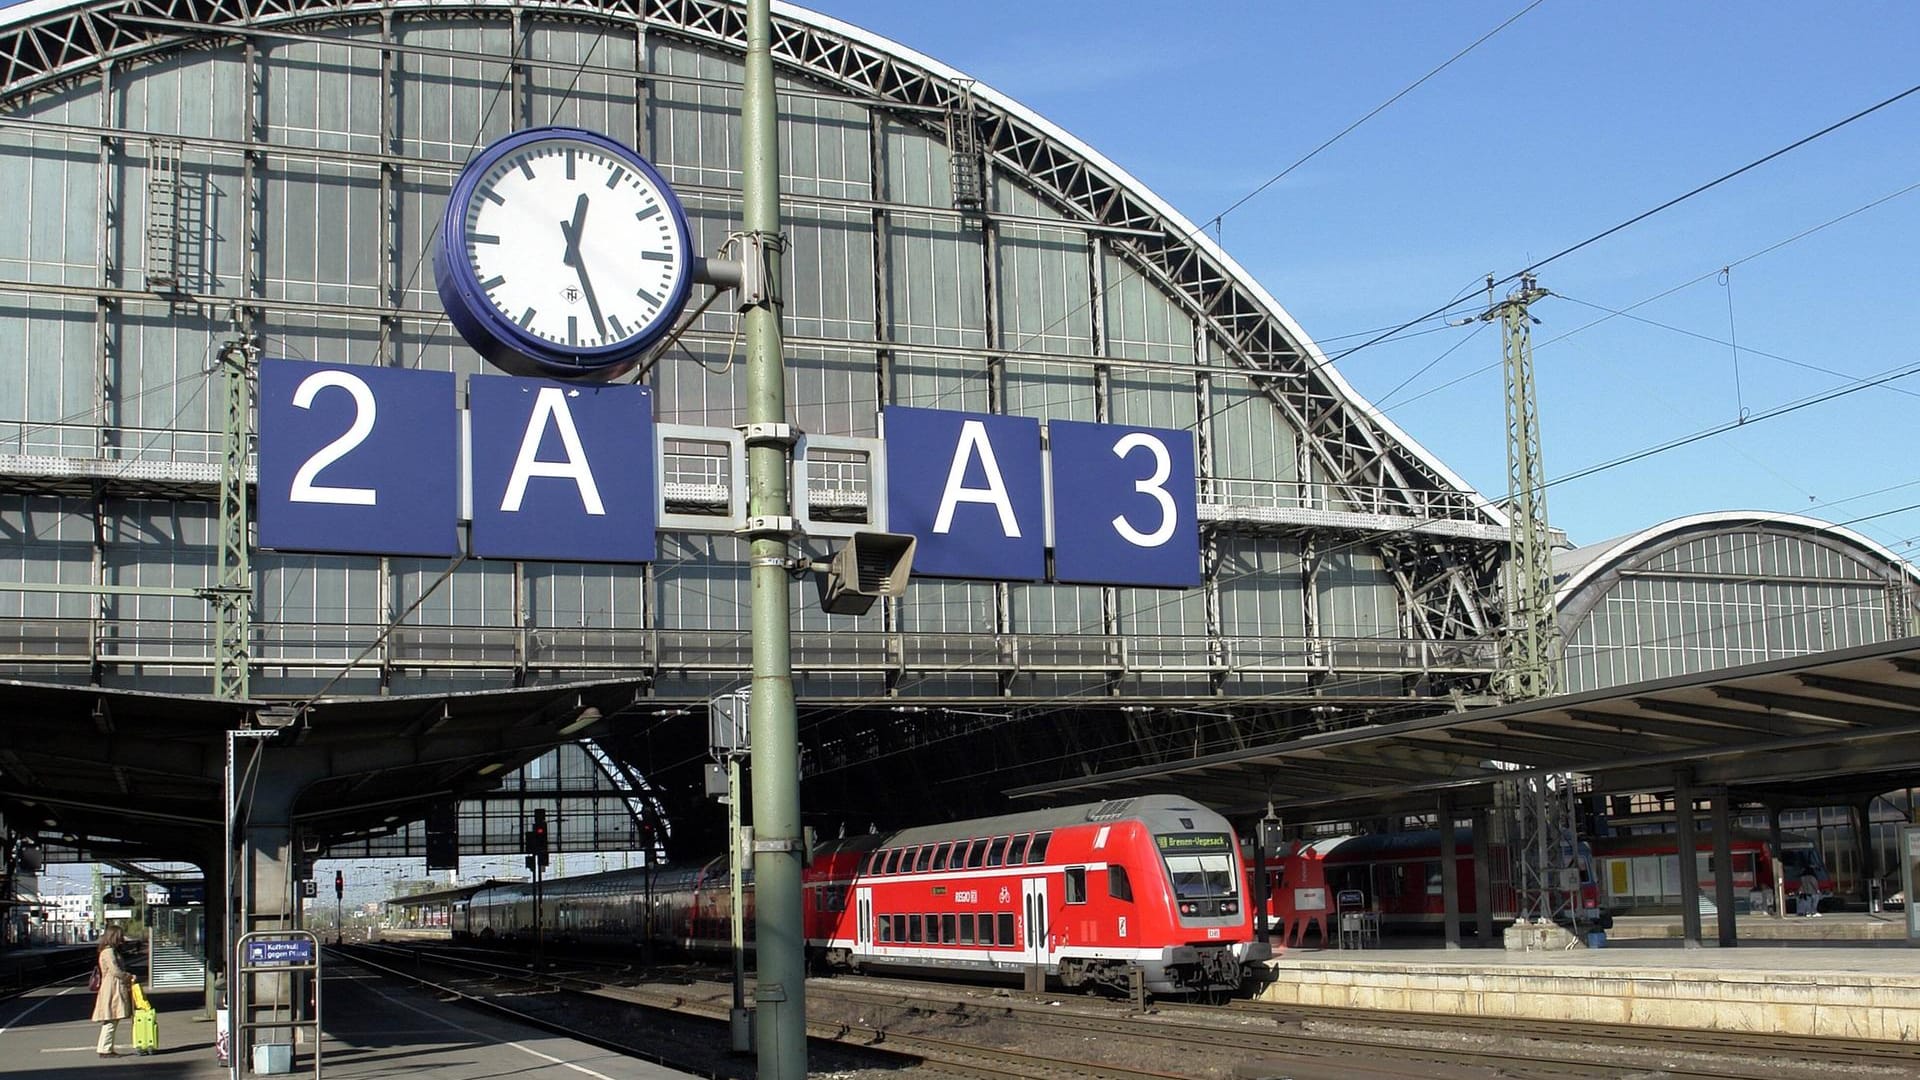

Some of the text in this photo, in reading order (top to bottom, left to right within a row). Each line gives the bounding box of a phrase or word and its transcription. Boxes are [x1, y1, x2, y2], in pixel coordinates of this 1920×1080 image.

[289, 371, 376, 505] 2
[501, 388, 606, 515] A
[932, 421, 1022, 538] A
[1112, 433, 1177, 547] 3
[305, 882, 316, 895] B
[1168, 837, 1224, 848] Bremen-Vegesack
